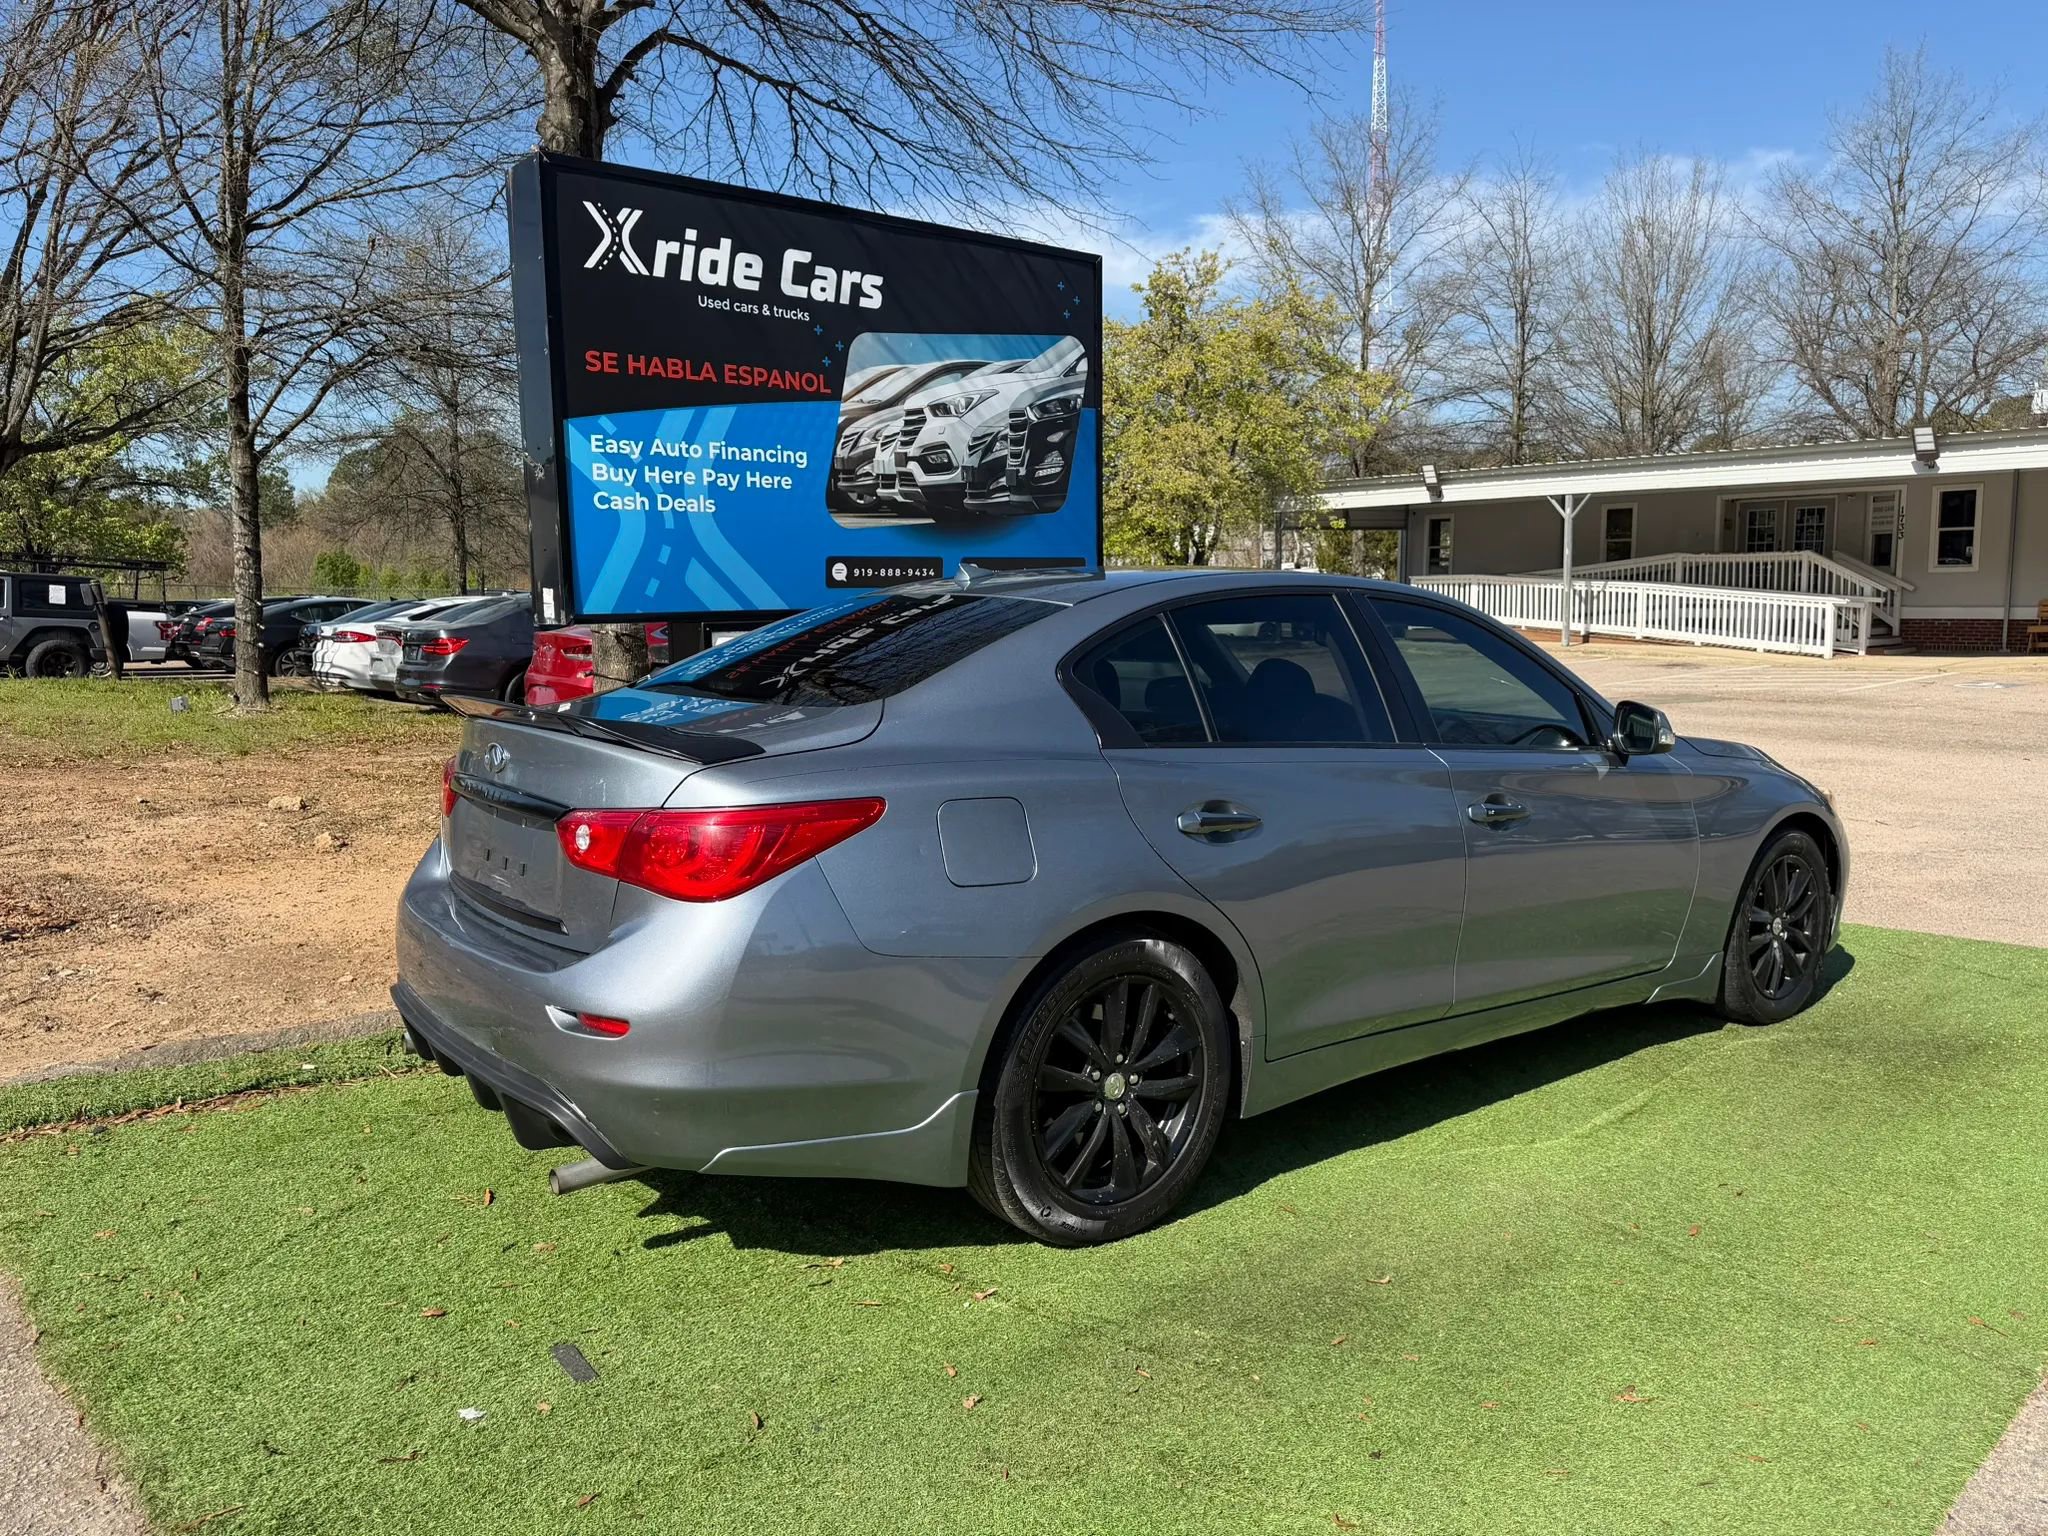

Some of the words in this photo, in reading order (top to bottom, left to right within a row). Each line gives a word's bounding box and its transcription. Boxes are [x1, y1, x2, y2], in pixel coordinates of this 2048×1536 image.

[780, 248, 884, 310] Cars
[698, 295, 730, 310] Used
[734, 302, 759, 315] cars
[762, 304, 771, 316] &
[773, 306, 811, 321] trucks
[585, 350, 620, 374] SE
[627, 353, 718, 383] HABLA
[724, 363, 832, 394] ESPANOL
[590, 434, 643, 459] Easy
[650, 438, 703, 459] Auto
[708, 440, 808, 468] Financing
[592, 463, 637, 487] Buy
[644, 466, 696, 486] Here
[702, 468, 740, 491] Pay
[746, 471, 793, 490] Here
[593, 491, 649, 511] Cash
[657, 494, 716, 513] Deals
[853, 567, 935, 577] 919-888-9434
